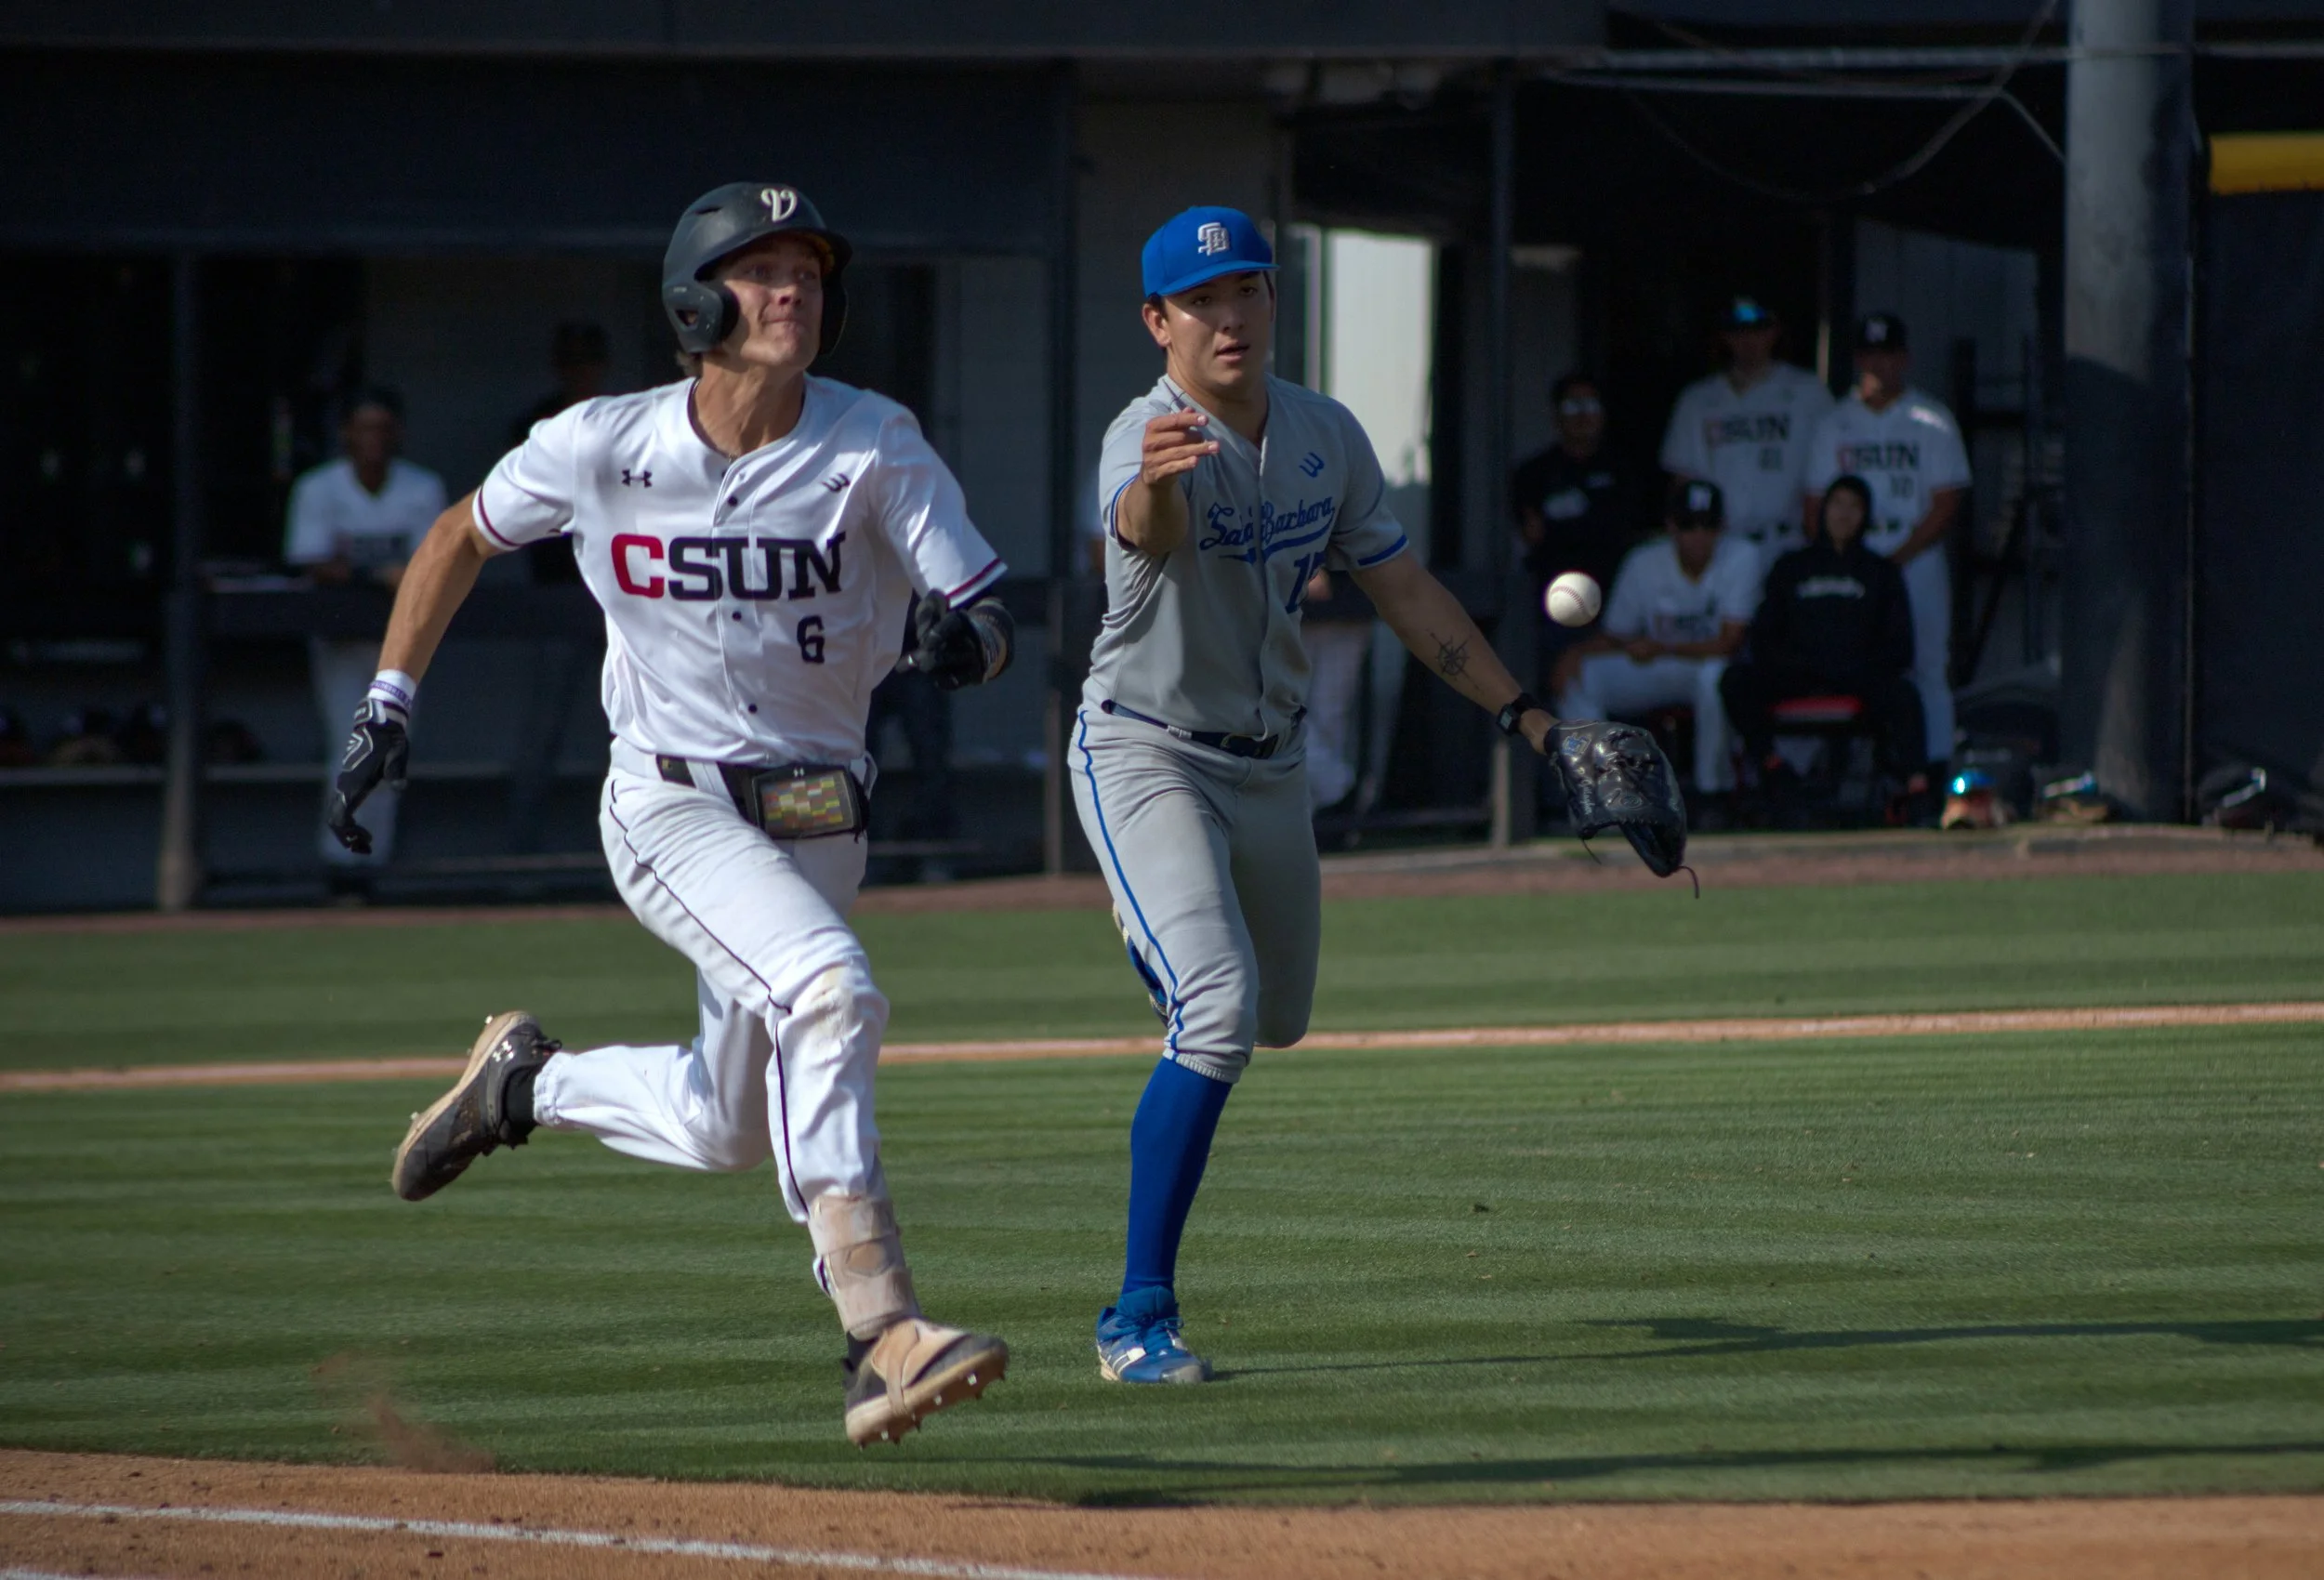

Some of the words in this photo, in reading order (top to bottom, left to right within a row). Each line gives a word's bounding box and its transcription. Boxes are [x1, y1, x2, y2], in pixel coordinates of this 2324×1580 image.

[1260, 496, 1333, 545] Barbara
[611, 531, 846, 601] CSUN
[796, 614, 825, 665] 6
